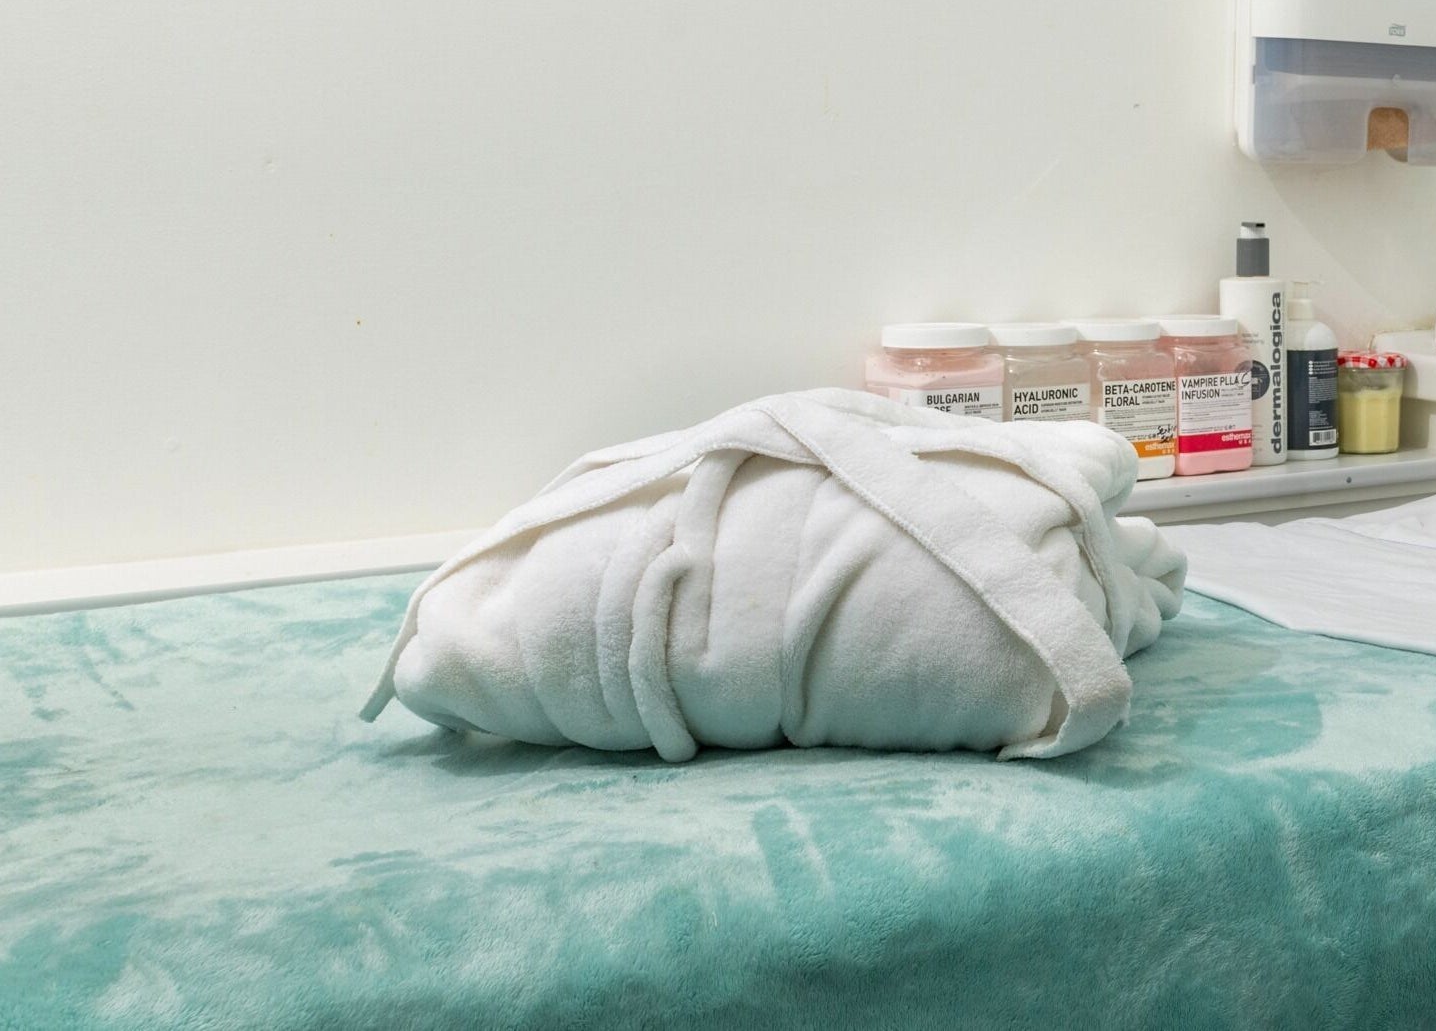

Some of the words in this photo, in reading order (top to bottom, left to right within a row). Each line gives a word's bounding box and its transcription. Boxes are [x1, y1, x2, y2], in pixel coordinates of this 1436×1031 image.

[1269, 292, 1283, 454] dermalogica
[1104, 380, 1176, 396] BETA-CAROTENE
[1181, 377, 1218, 389] VAMPIRE
[1219, 376, 1239, 387] PLLA
[926, 392, 980, 406] BULGARIAN
[1013, 387, 1078, 403] HYALURONIC
[1181, 388, 1220, 400] INFUSION
[1104, 396, 1140, 408] FLORAL
[1014, 403, 1039, 416] ACID
